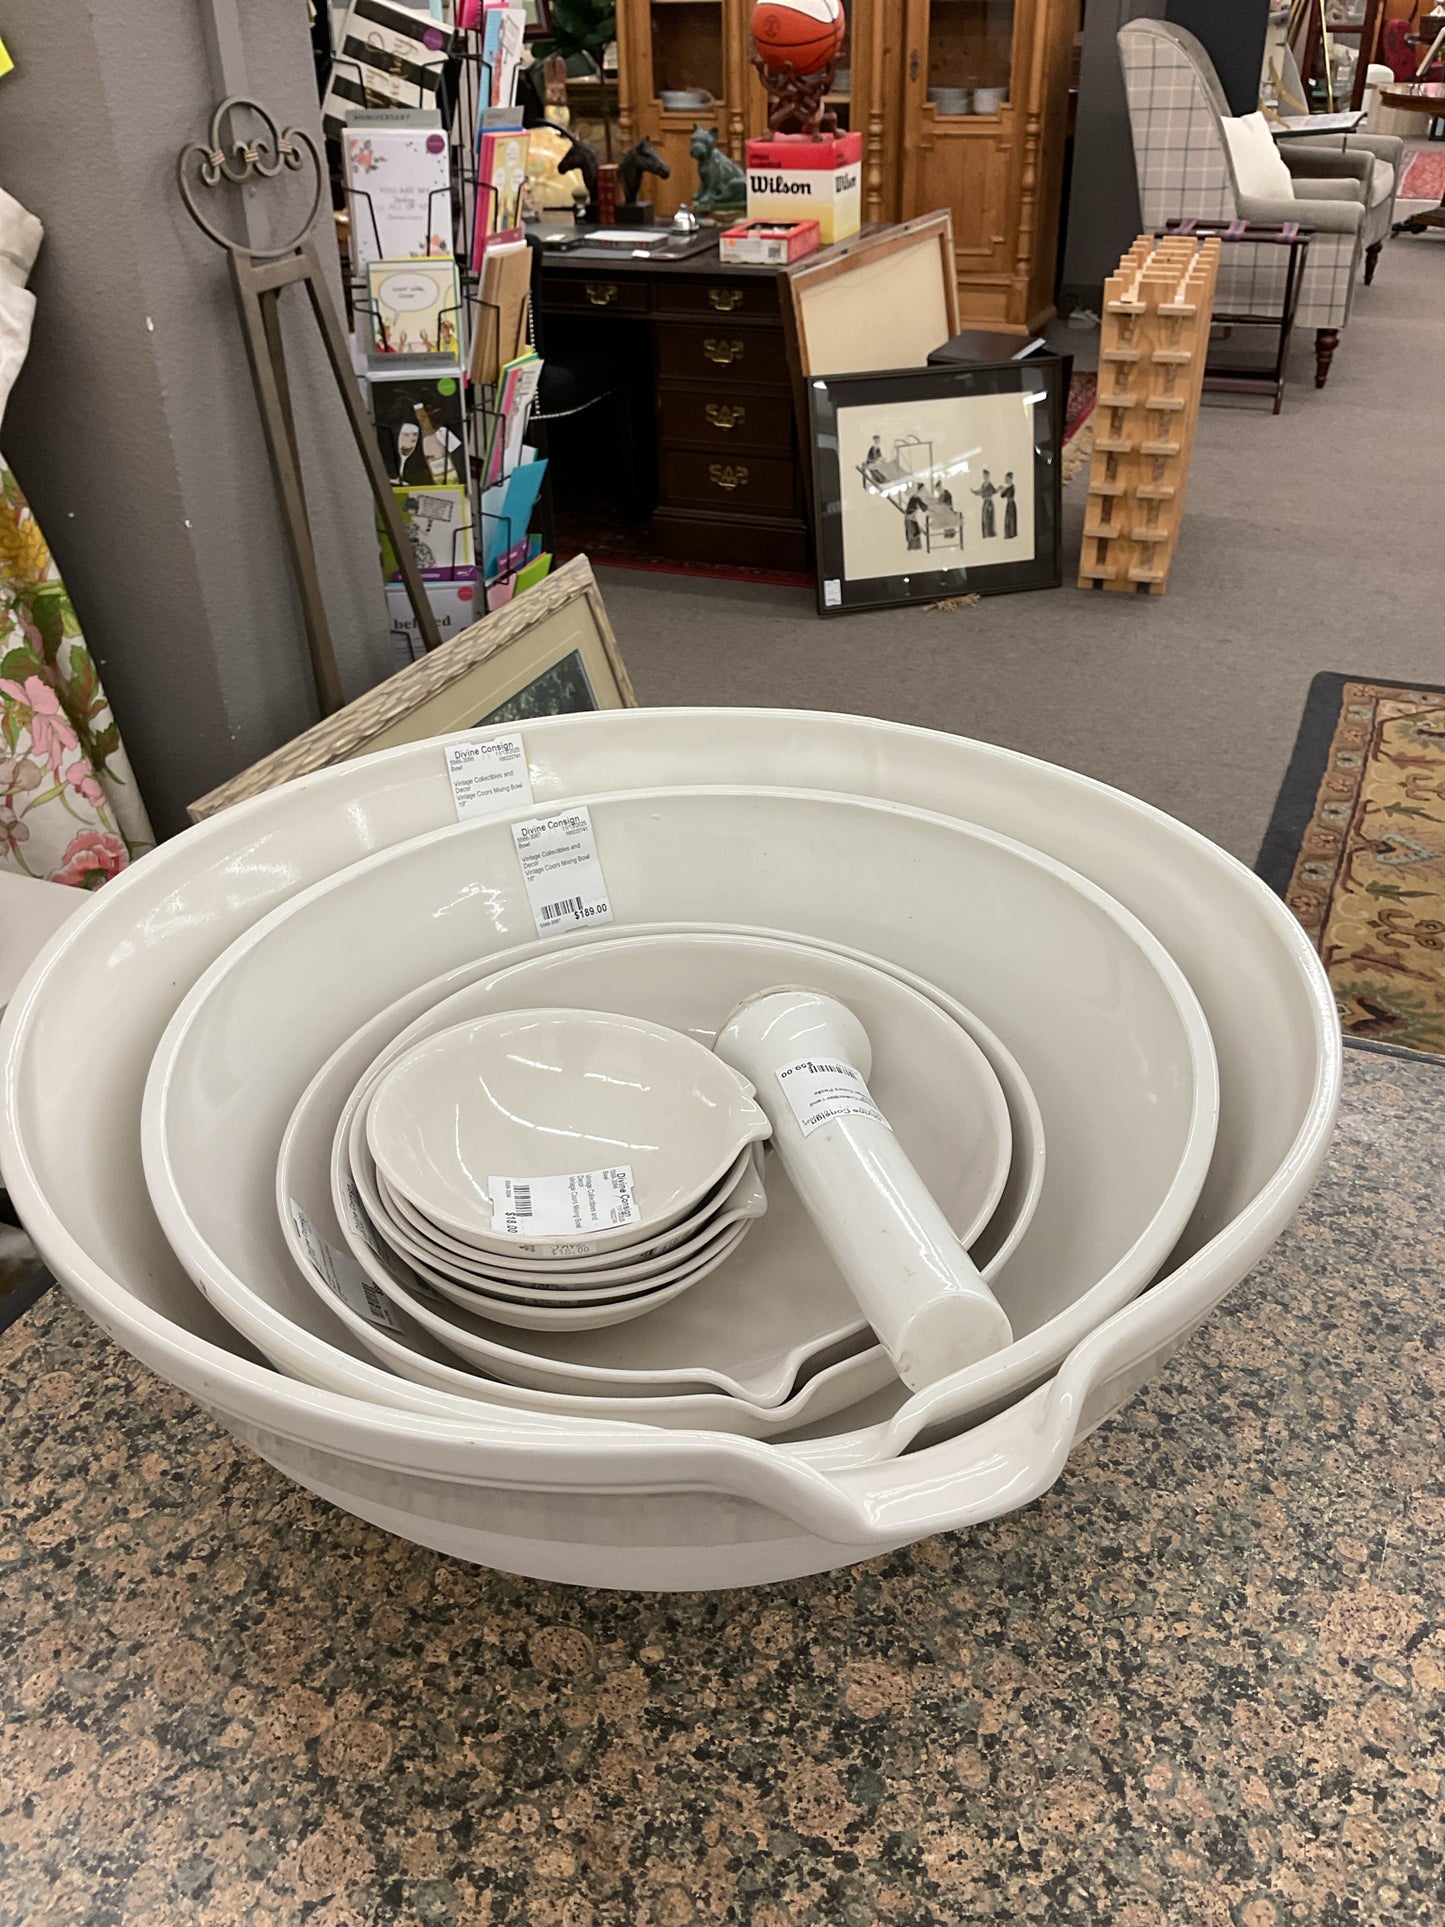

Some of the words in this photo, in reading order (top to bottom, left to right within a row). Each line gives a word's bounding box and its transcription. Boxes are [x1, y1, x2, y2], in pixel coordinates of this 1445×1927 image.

[750, 175, 811, 195] Wilson
[455, 748, 479, 759] Divine
[481, 742, 513, 753] Consign
[474, 774, 502, 783] Collectibles
[455, 786, 470, 794] Decor
[477, 789, 492, 797] Coors
[511, 782, 522, 790] Bowl
[522, 824, 546, 836] Divine
[548, 816, 580, 829] Consign
[522, 853, 541, 862] Vintage
[542, 847, 570, 857] Collectibles
[523, 861, 539, 869] Decor
[525, 867, 544, 875] Vintage
[561, 857, 577, 866] Mixing
[578, 854, 590, 862] Bowl
[574, 904, 607, 920] $189.00
[781, 1062, 814, 1078] $59.00
[811, 1108, 850, 1124] Consign
[569, 1176, 578, 1191] Vintage
[616, 1172, 626, 1193] Divine
[620, 1194, 632, 1217] Consign
[505, 1212, 518, 1233] $18.00
